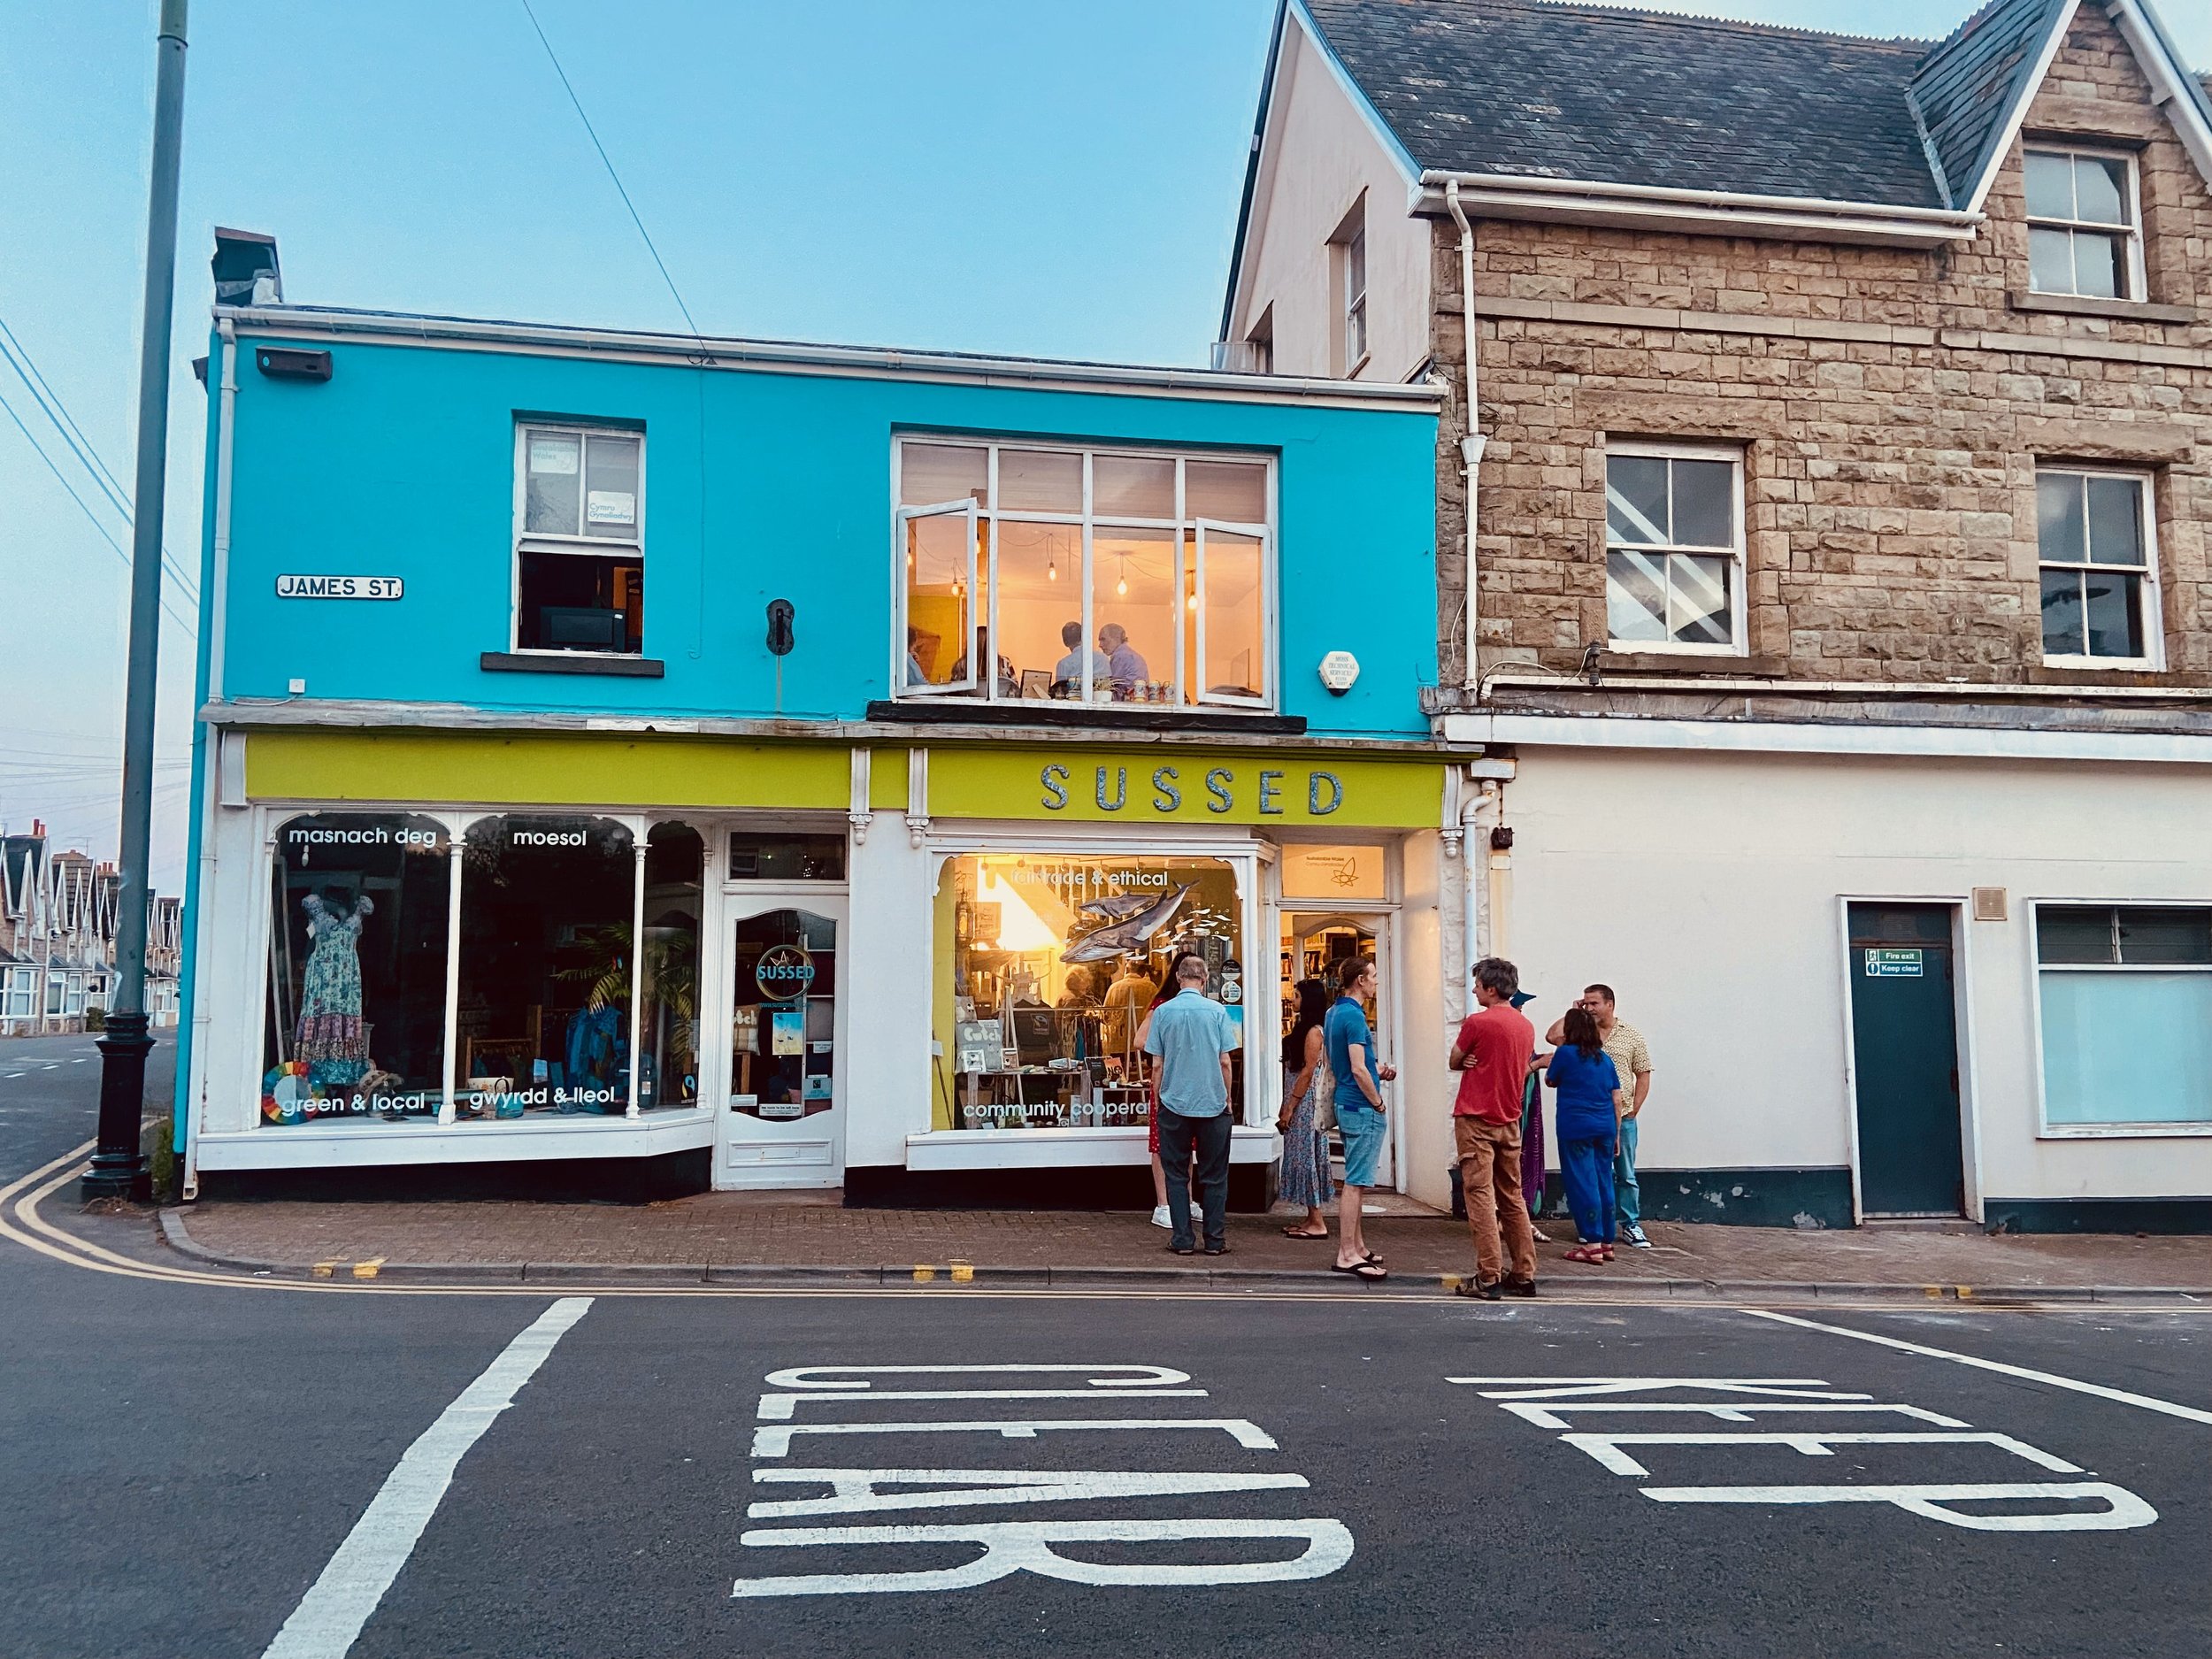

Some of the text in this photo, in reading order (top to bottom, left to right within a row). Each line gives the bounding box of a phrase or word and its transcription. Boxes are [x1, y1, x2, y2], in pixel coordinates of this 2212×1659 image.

[589, 503, 615, 511] Cymru
[280, 577, 399, 596] JAMES ST.
[1041, 764, 1343, 815] SUSSED
[288, 827, 436, 849] masnach deg
[513, 830, 587, 846] moesol
[1091, 870, 1104, 886] &
[1110, 870, 1168, 886] ethical
[757, 965, 814, 979] SUSSED
[1881, 964, 1900, 973] Keep
[281, 1092, 425, 1117] green & local
[469, 1086, 615, 1110] gwyrdd & lleol
[963, 1100, 1065, 1118] community
[1445, 1377, 2159, 1531] KEEP
[730, 1363, 1355, 1597] CLEAR
